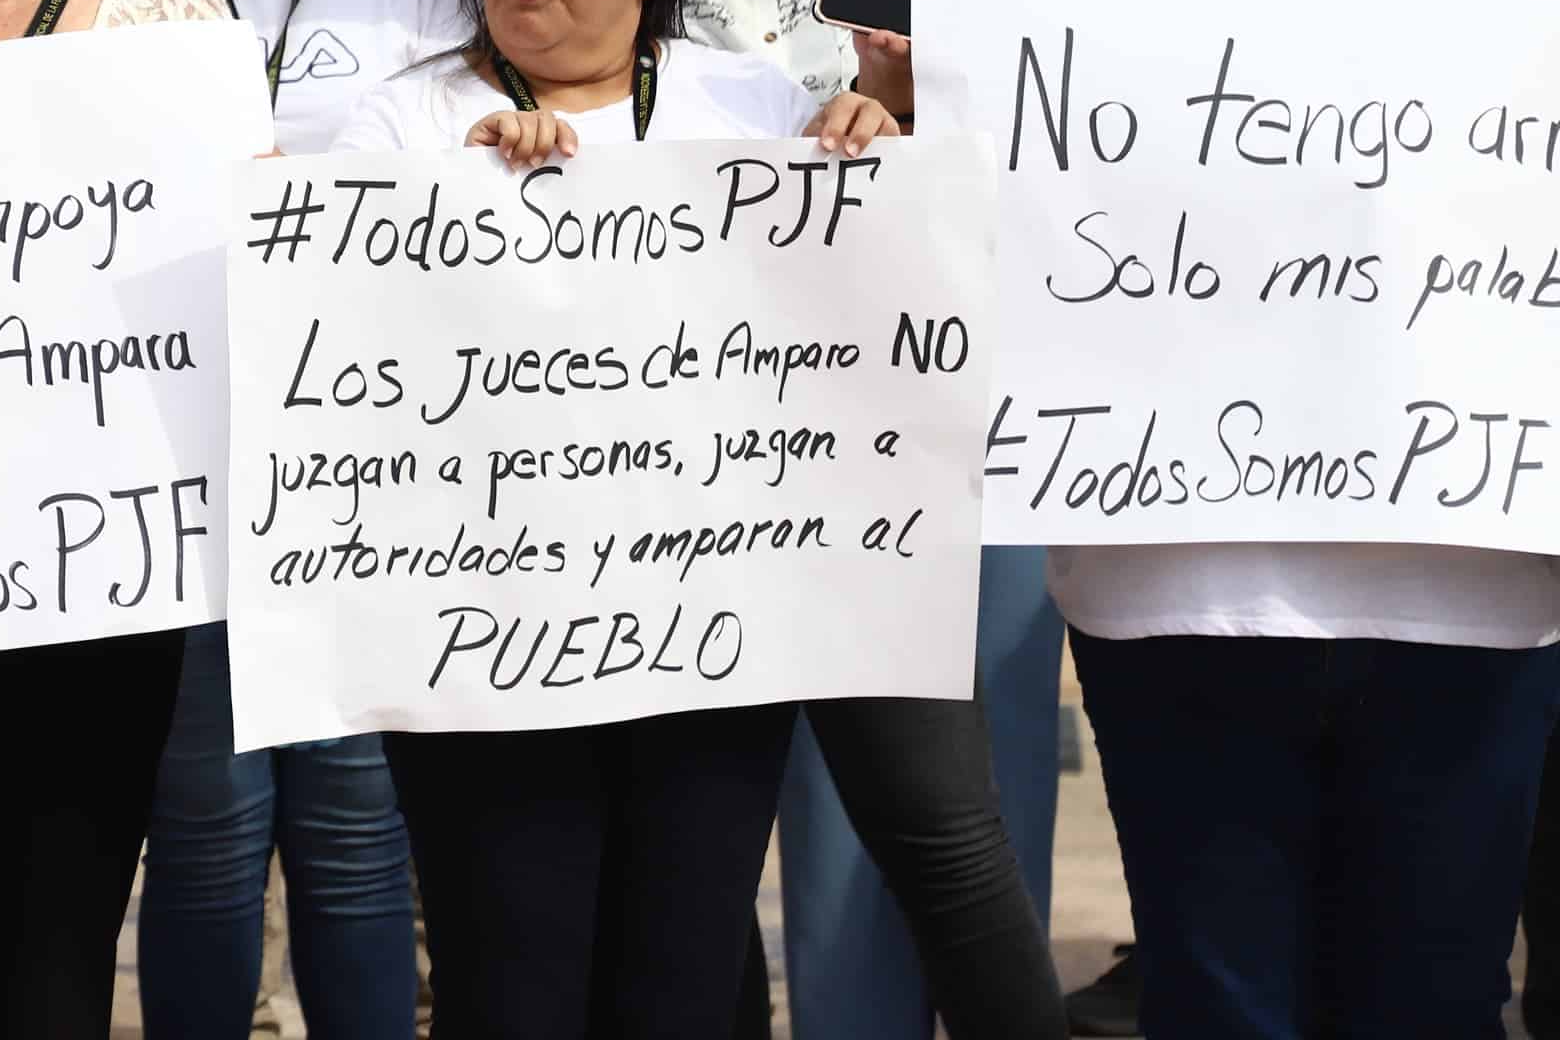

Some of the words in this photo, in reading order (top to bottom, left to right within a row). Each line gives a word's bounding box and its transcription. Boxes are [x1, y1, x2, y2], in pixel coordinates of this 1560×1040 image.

[1009, 26, 1138, 172] No
[1186, 37, 1432, 189] tengo
[1046, 210, 1220, 303] Solo
[1259, 254, 1382, 303] mis
[283, 318, 403, 410] Los
[641, 320, 699, 389] de
[715, 321, 860, 404] Amparo
[891, 312, 968, 374] NO
[251, 450, 416, 536] juzgan
[438, 456, 462, 485] a
[488, 440, 683, 520] personas,
[701, 427, 836, 487] juzgan
[874, 430, 900, 457] a
[270, 522, 565, 587] autoridades
[590, 534, 615, 589] y
[629, 516, 832, 583] amparan
[862, 508, 923, 558] al
[428, 603, 742, 691] PUEBLO
